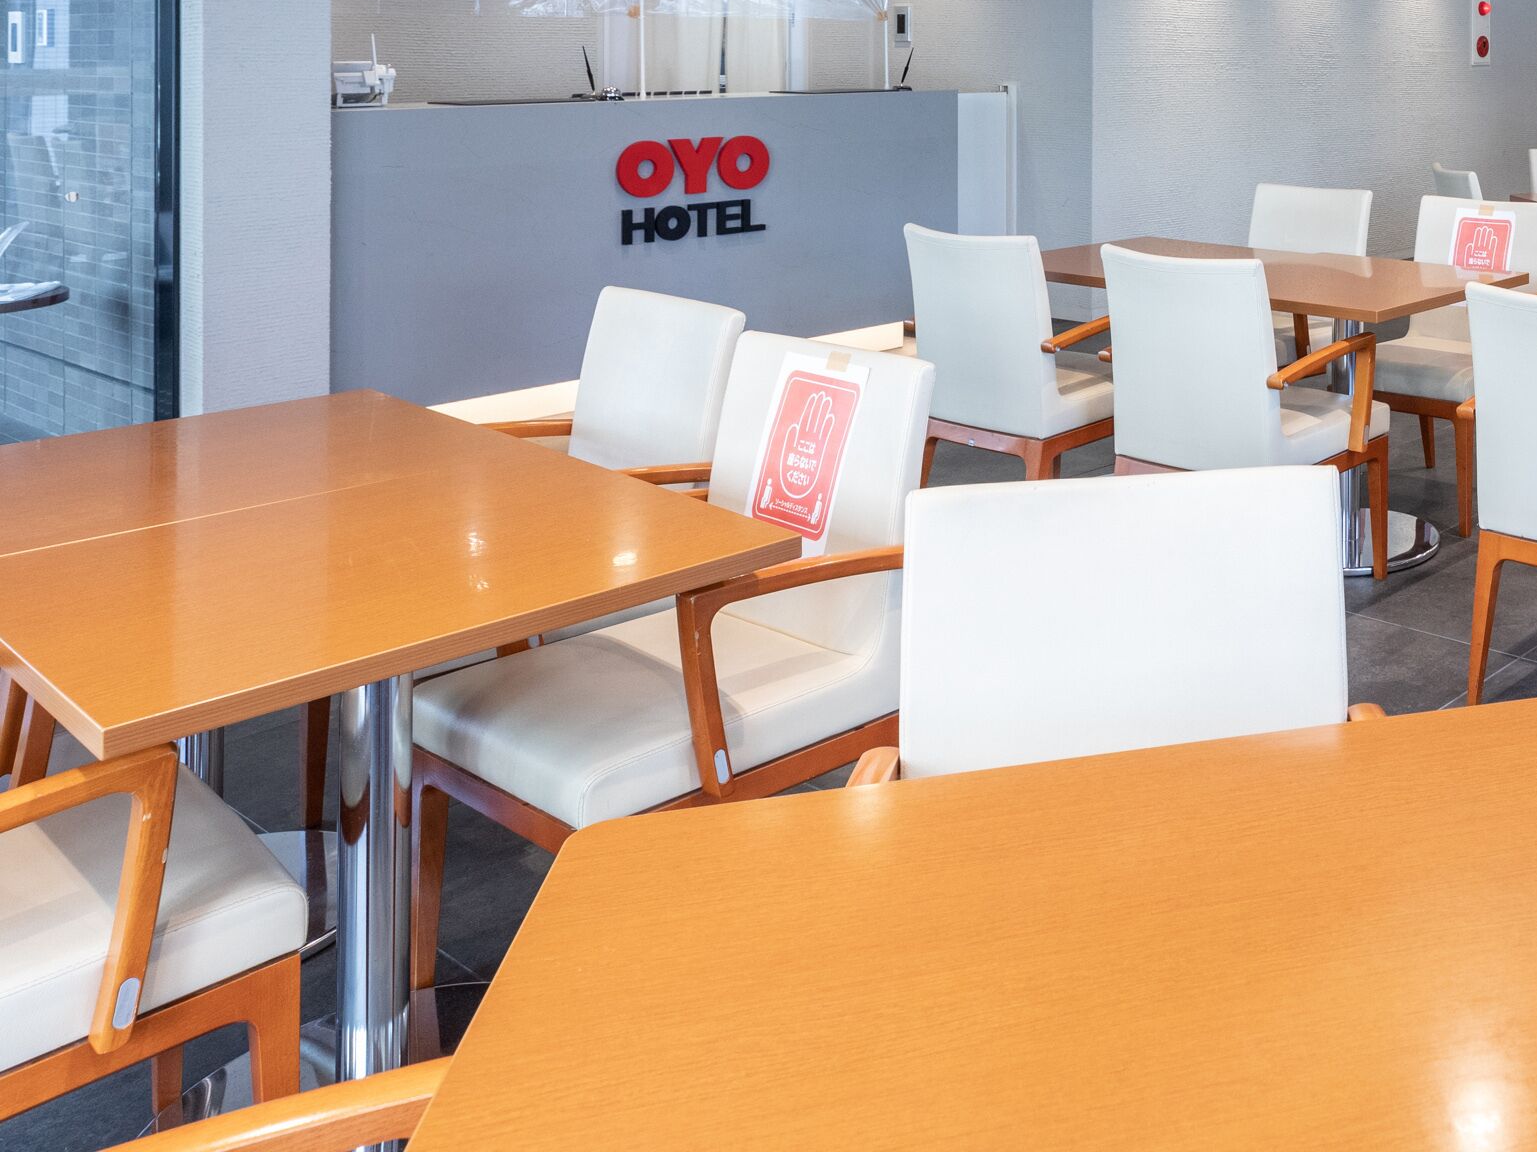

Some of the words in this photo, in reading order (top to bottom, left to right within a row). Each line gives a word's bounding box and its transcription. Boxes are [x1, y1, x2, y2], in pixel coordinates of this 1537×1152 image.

[616, 135, 770, 198] OYO
[621, 199, 767, 245] HOTEL
[798, 440, 816, 455] ここは
